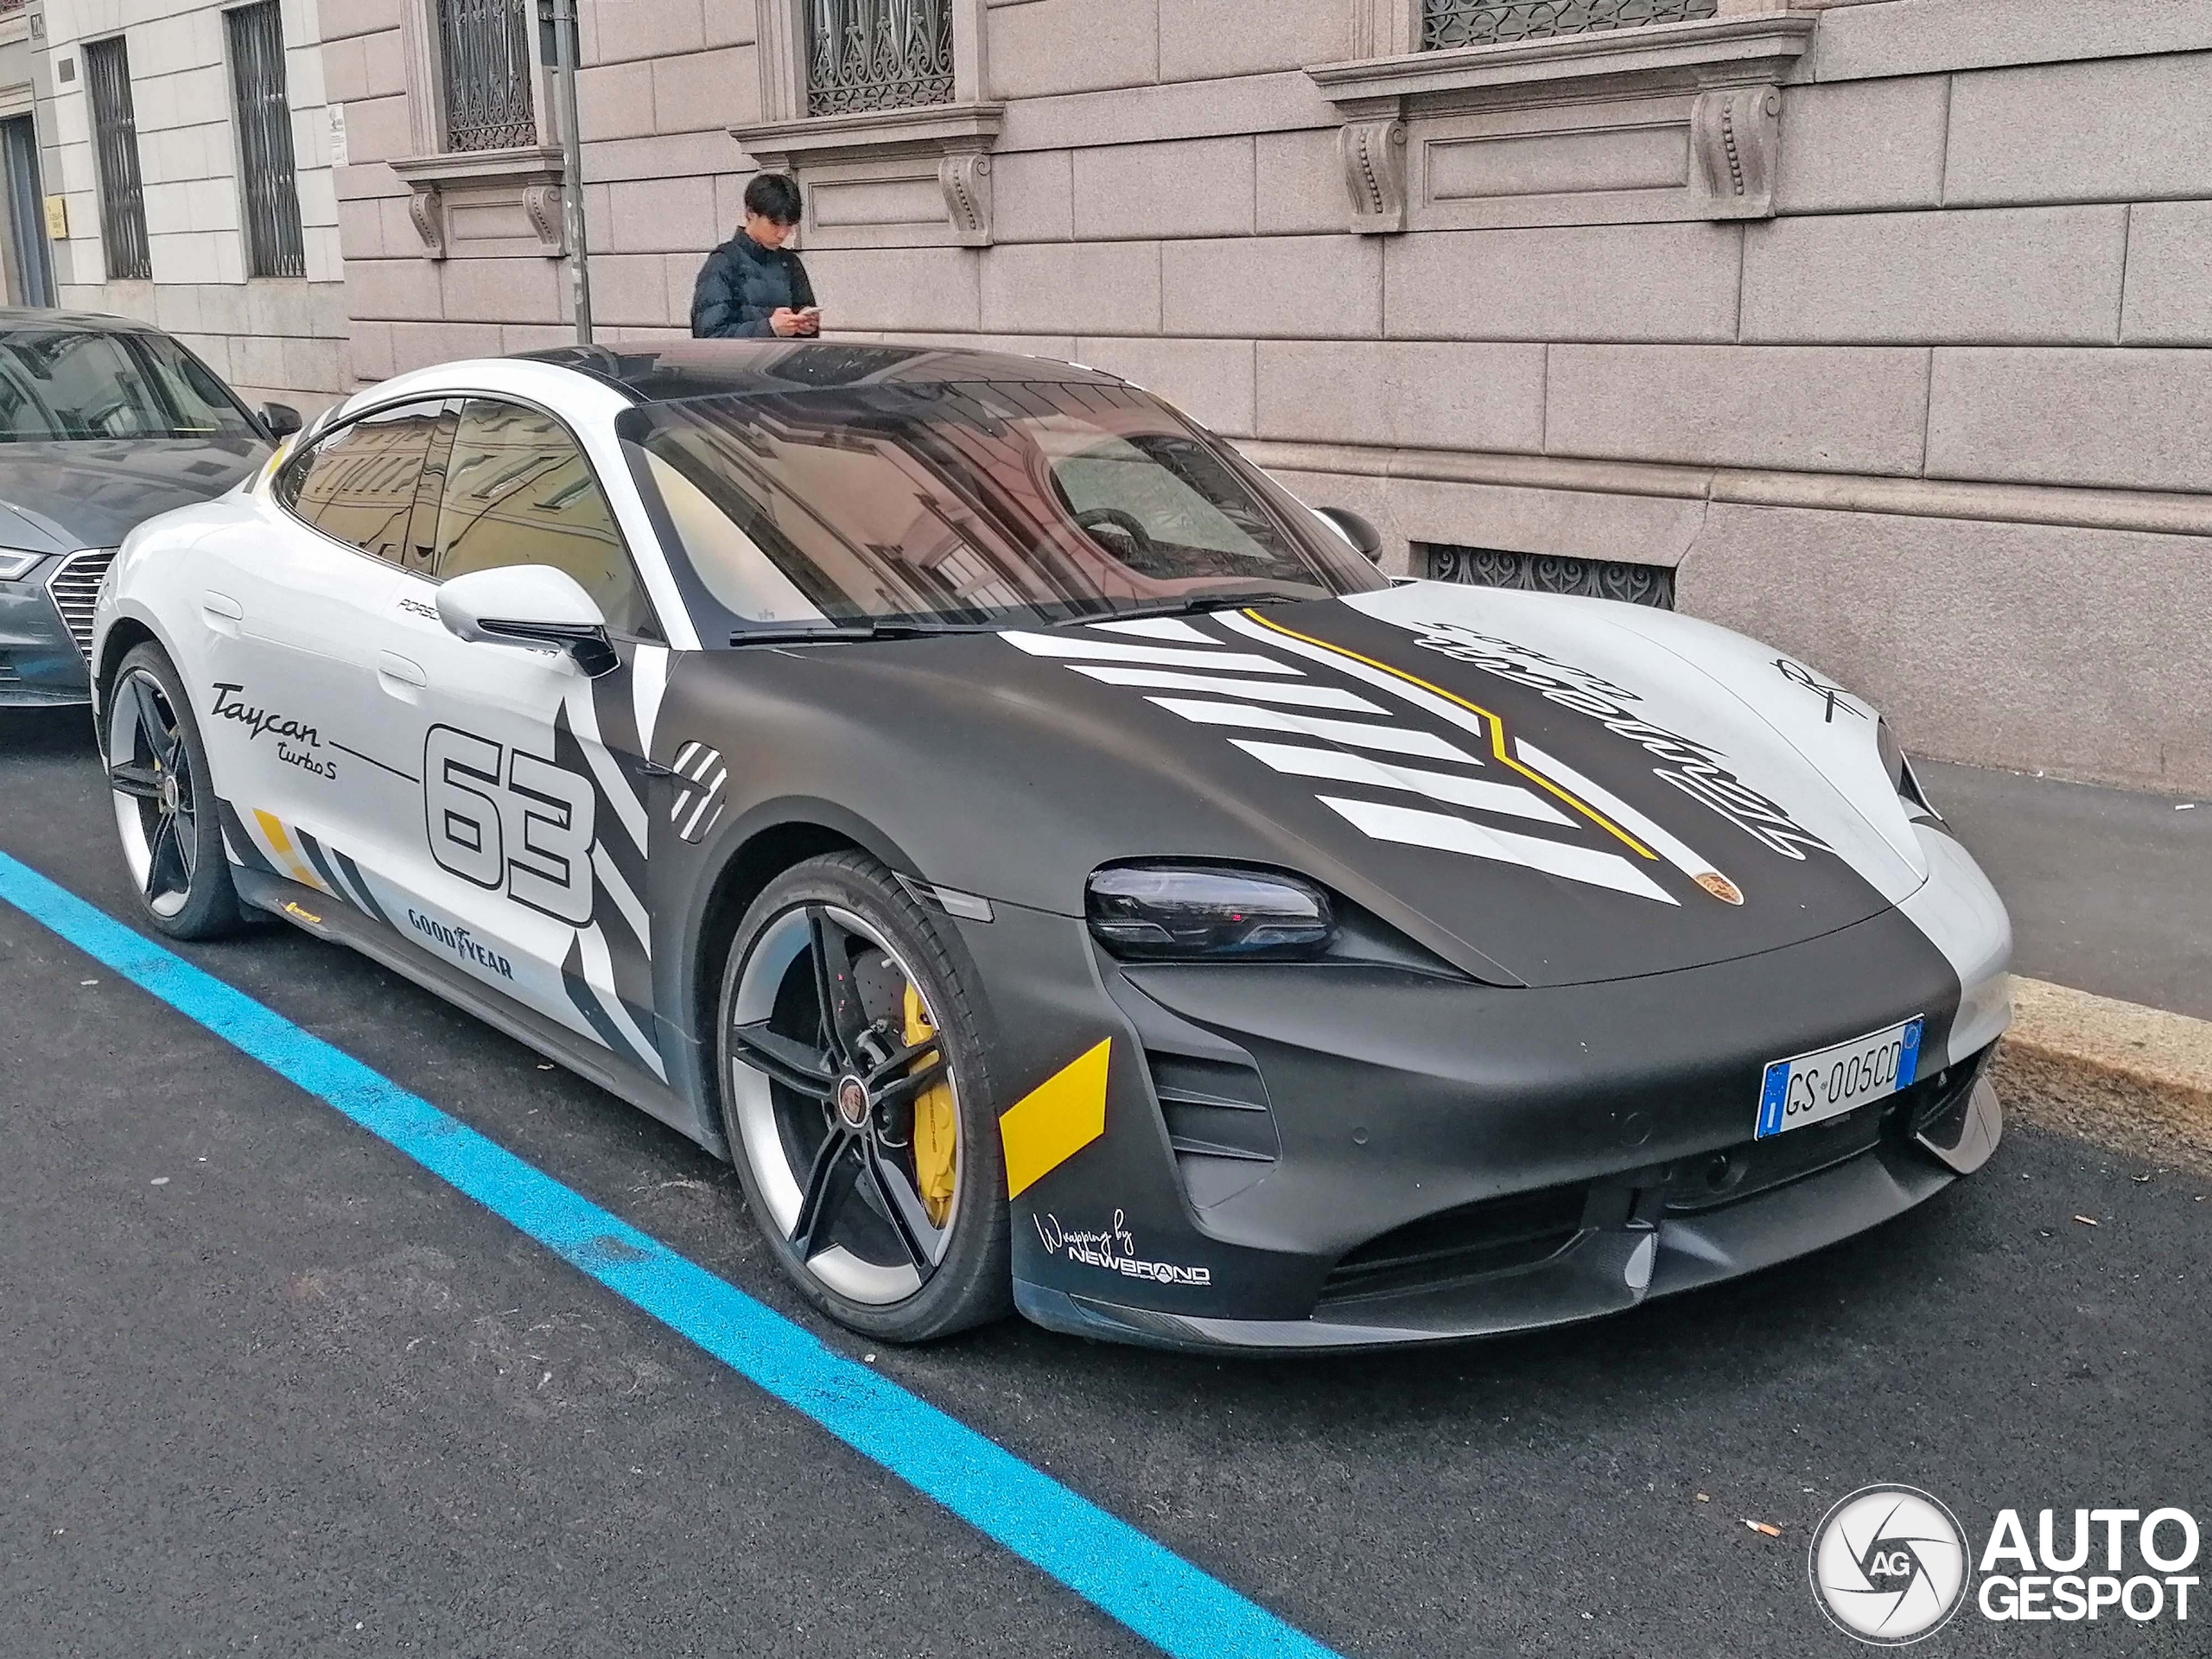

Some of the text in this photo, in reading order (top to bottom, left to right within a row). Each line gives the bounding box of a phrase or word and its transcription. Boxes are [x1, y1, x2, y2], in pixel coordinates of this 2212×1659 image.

[212, 682, 321, 748] Taycan
[277, 741, 338, 780] turbo S
[423, 722, 597, 929] 63
[1033, 1208, 1135, 1256] Wrapping by
[1068, 1246, 1211, 1284] NEWBRAND
